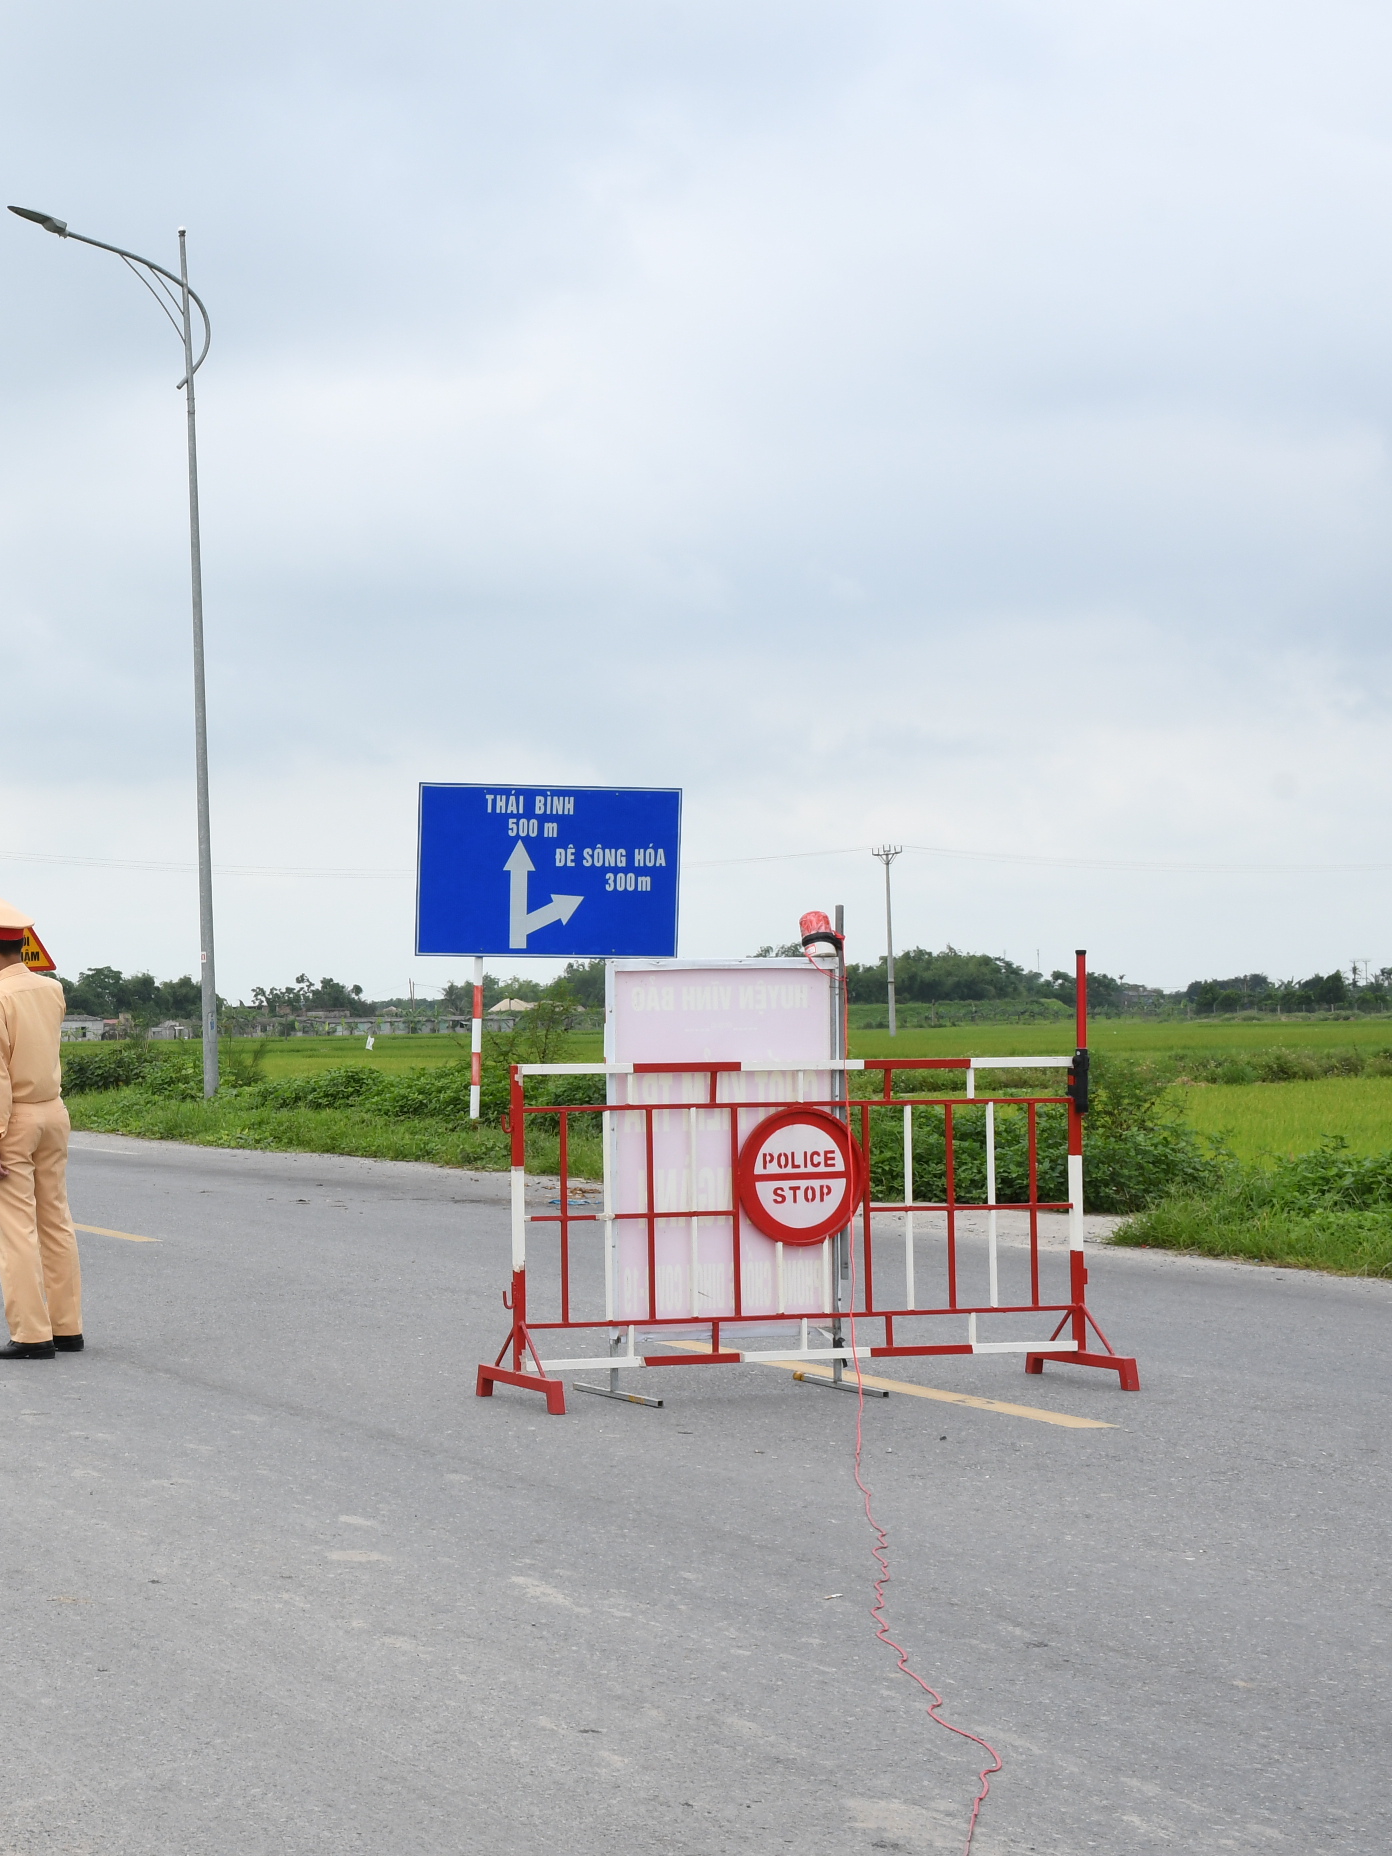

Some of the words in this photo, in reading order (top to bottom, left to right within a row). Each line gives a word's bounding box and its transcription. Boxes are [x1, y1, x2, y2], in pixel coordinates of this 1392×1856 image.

[485, 790, 524, 814] THÁI
[534, 791, 575, 815] BÌNH
[508, 818, 538, 837] 500
[544, 821, 558, 837] m
[555, 844, 576, 867] ĐÊ
[583, 844, 626, 868] SÔNG
[634, 843, 666, 867] HÓA
[762, 1150, 836, 1170] POLICE
[773, 1184, 832, 1204] STOP
